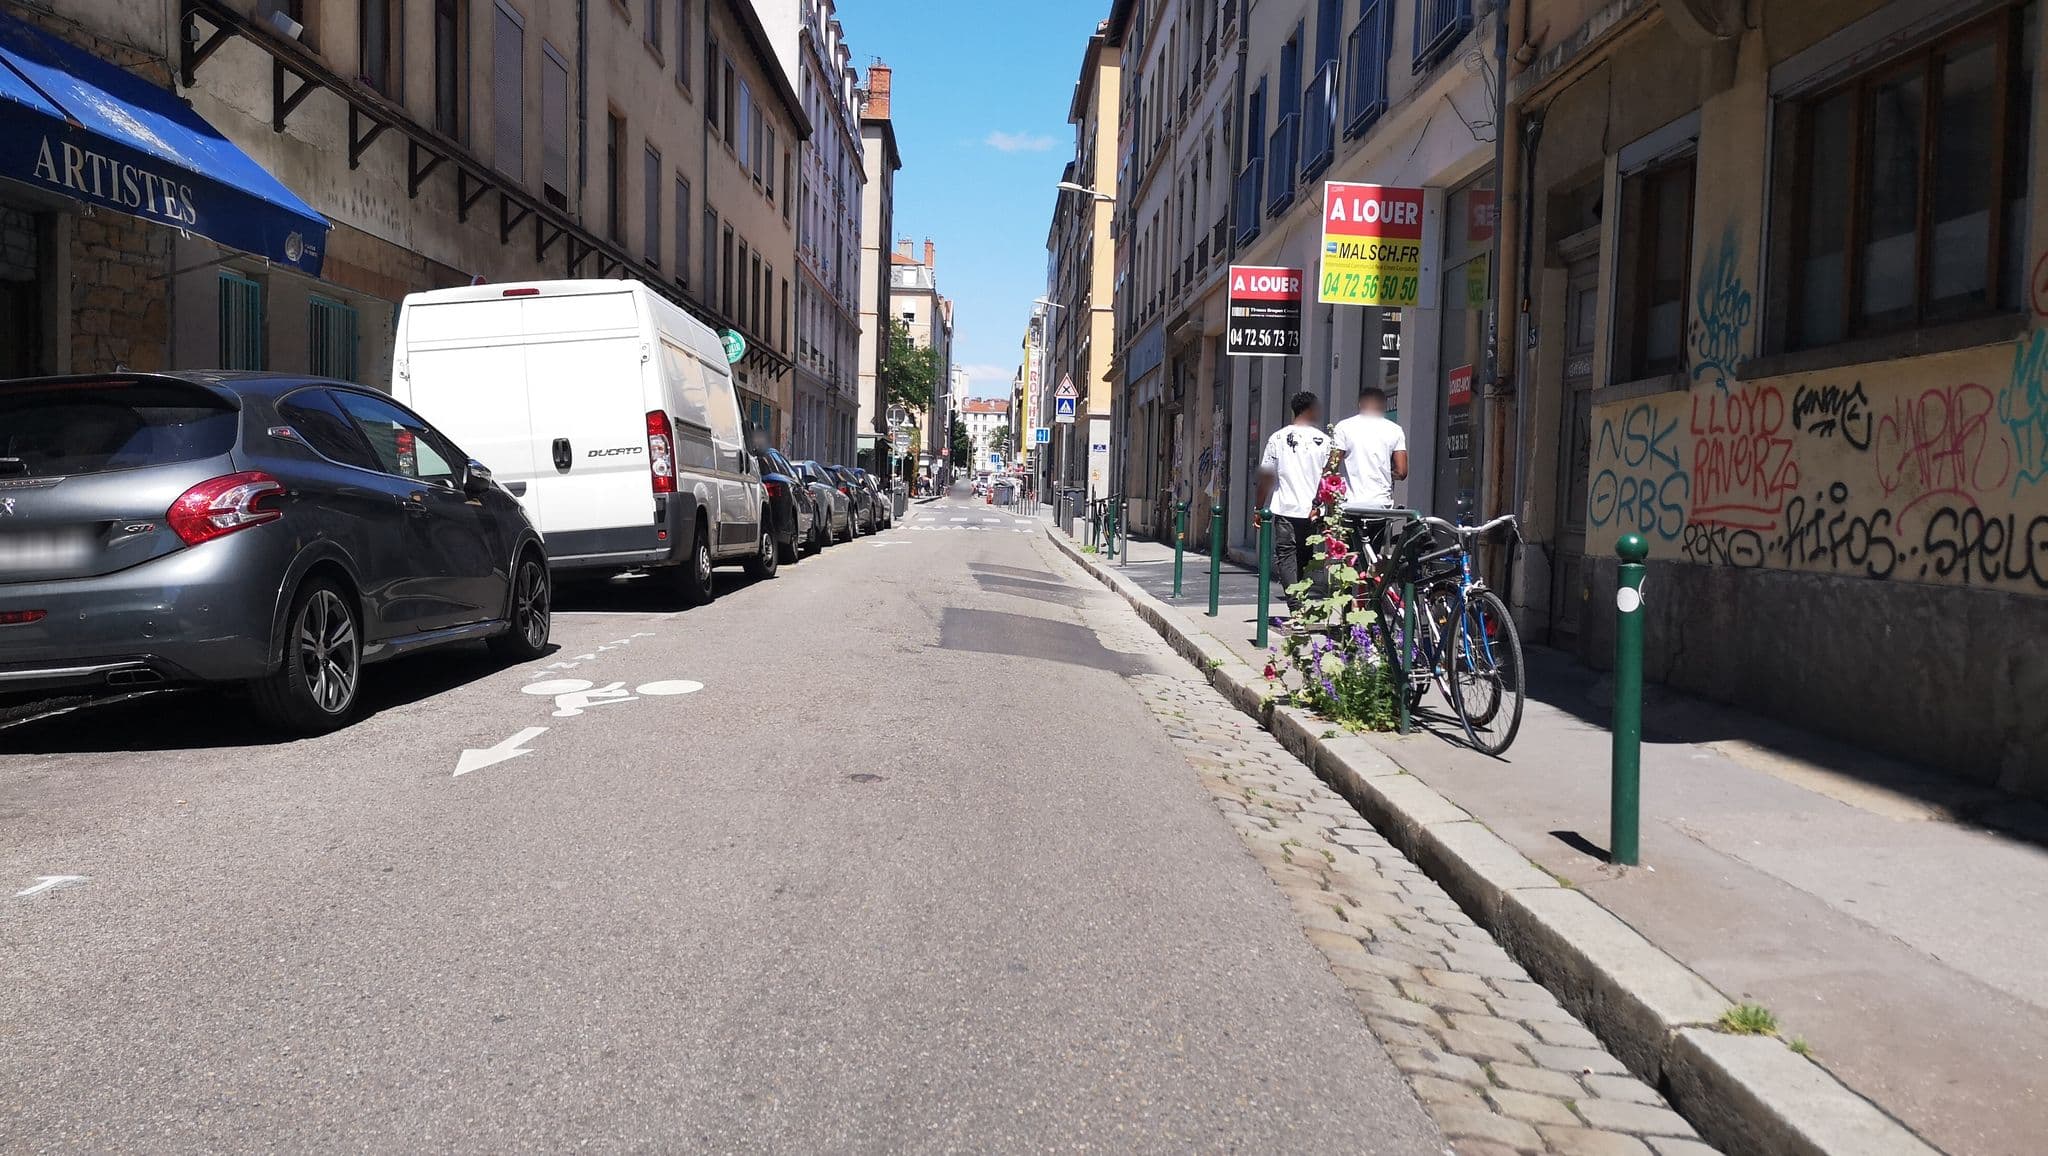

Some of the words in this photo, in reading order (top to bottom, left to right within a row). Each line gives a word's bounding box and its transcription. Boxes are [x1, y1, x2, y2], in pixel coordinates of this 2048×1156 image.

[33, 135, 197, 225] ARTISTES
[1330, 197, 1346, 222] A
[1352, 198, 1418, 225] LOUER
[1339, 242, 1419, 263] MALSCH.FR
[1233, 275, 1246, 291] A
[1250, 275, 1299, 293] LOUER
[1323, 272, 1340, 296] 04
[1343, 273, 1360, 297] 72
[1362, 274, 1379, 299] 56
[1380, 275, 1399, 300] 50
[1400, 275, 1418, 301] 50
[1230, 328, 1242, 346] 04
[1245, 328, 1256, 346] 72
[1258, 329, 1271, 346] 56
[1273, 329, 1285, 346] 73
[1287, 330, 1299, 346] 73
[1690, 386, 1784, 438] LLOYD
[588, 446, 643, 458] DUCATO
